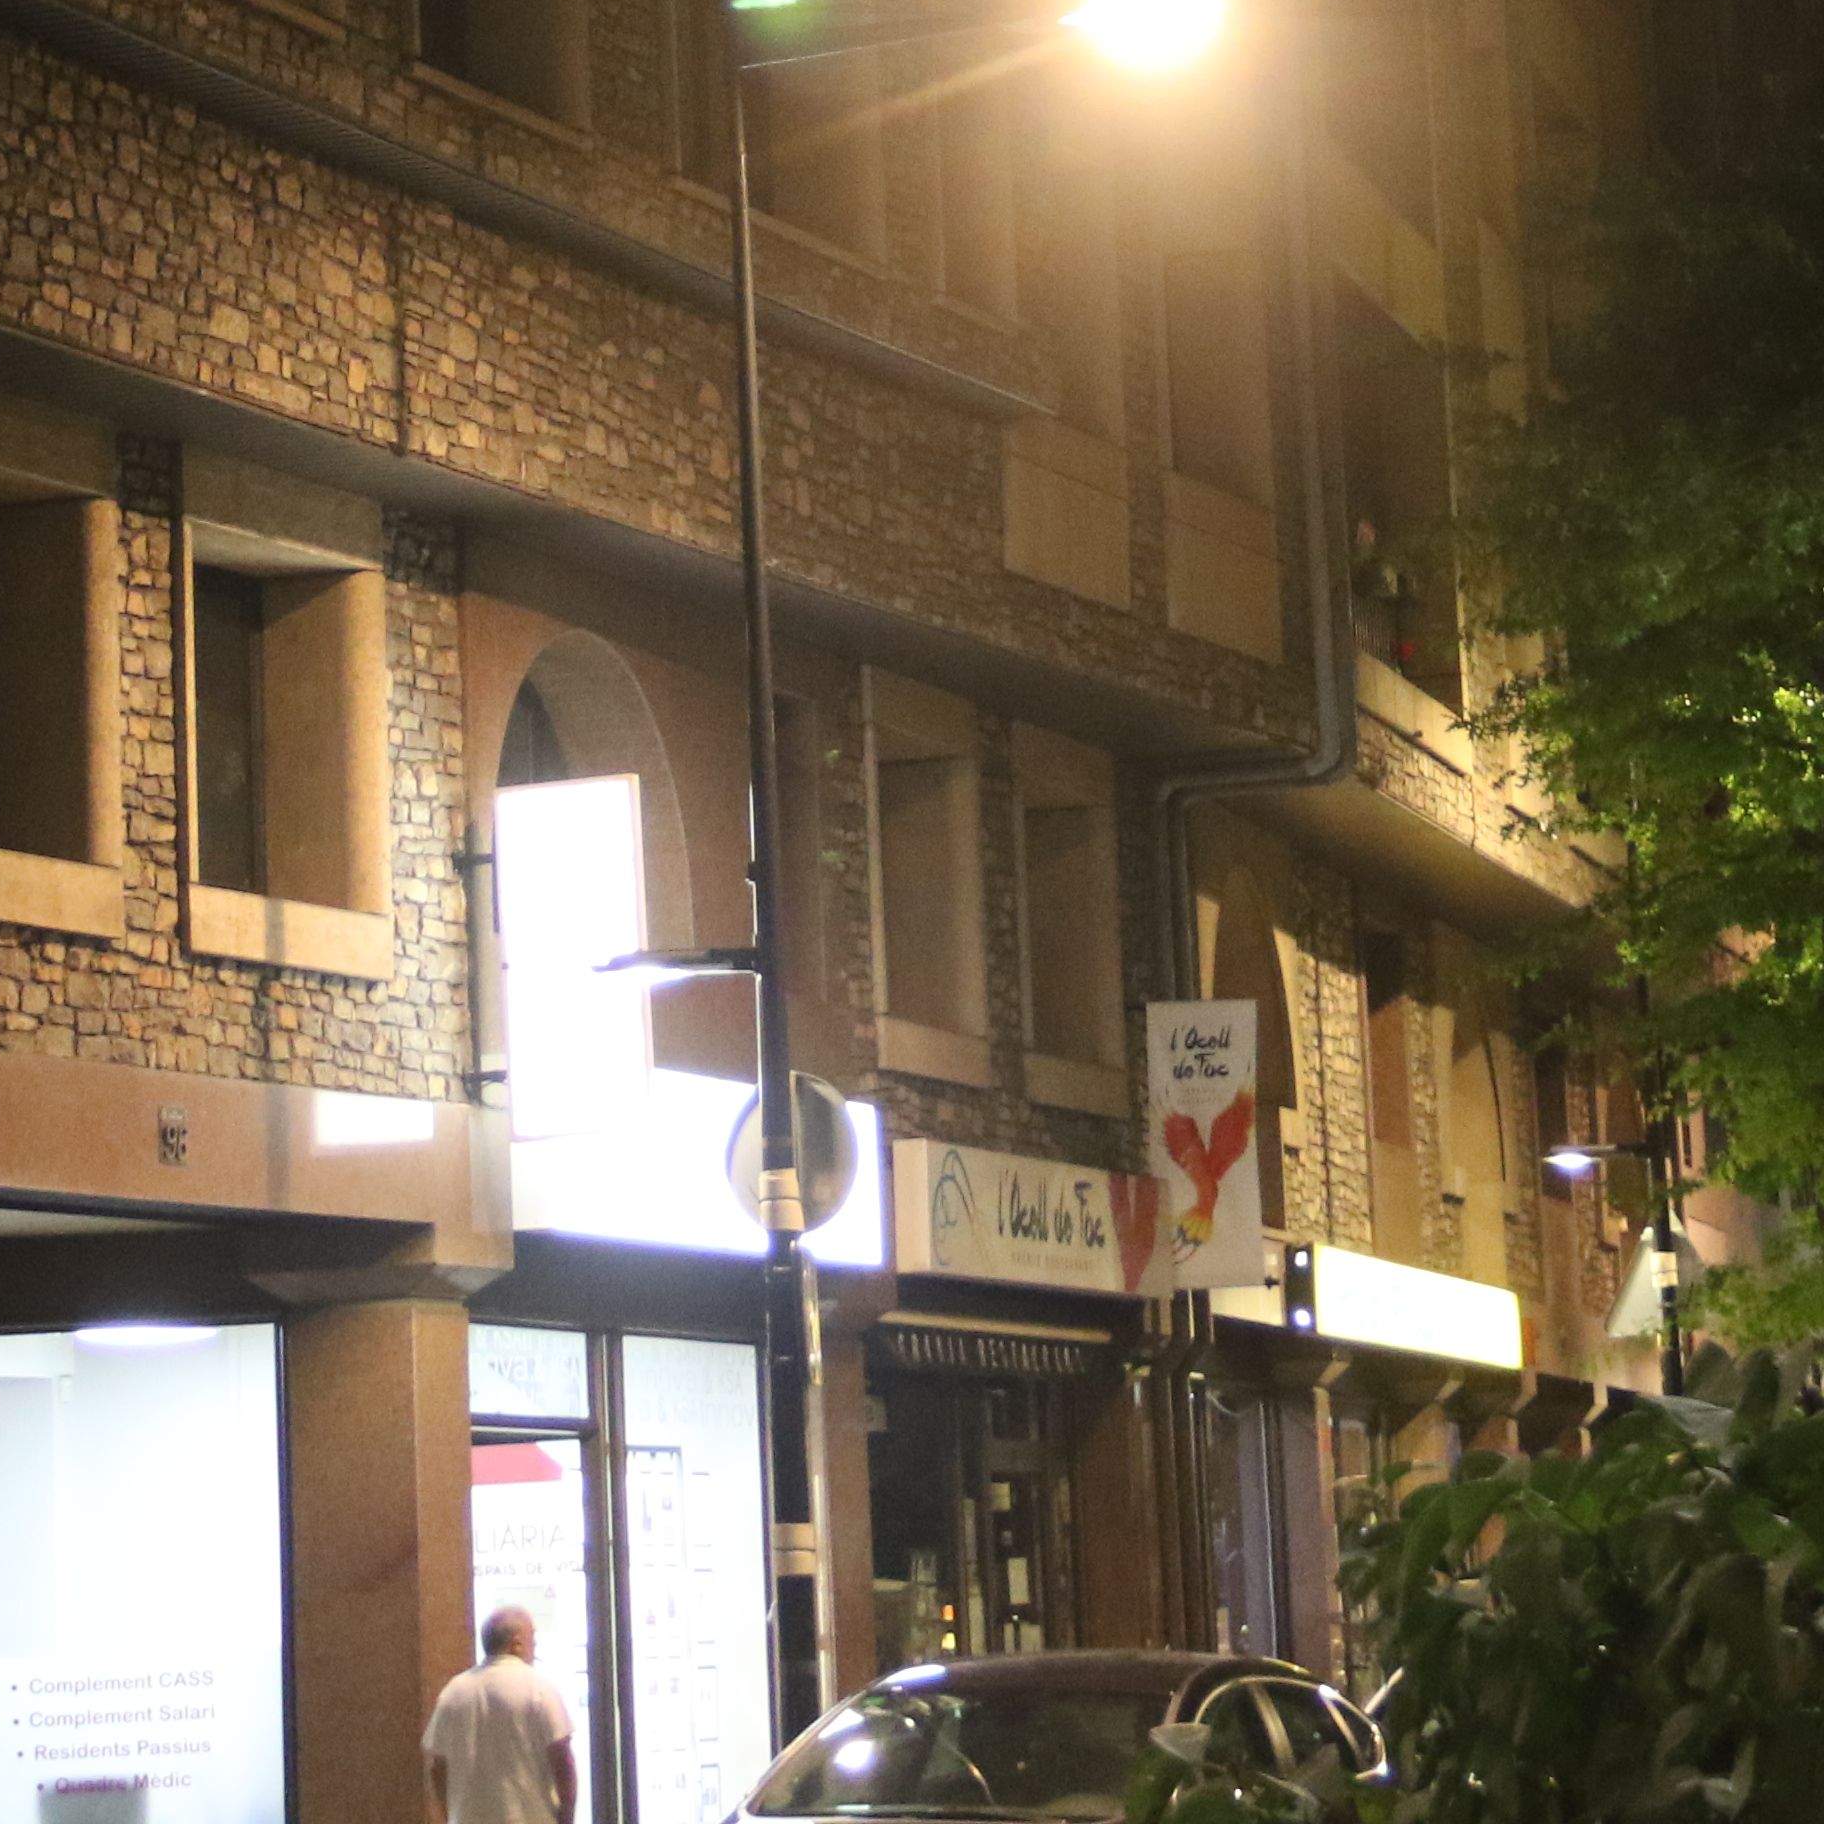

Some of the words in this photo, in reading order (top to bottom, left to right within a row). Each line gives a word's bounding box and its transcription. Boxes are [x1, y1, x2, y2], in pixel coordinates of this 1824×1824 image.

[29, 1674, 153, 1696] Complement
[158, 1670, 215, 1688] CASS
[29, 1707, 153, 1729] Complement
[159, 1704, 216, 1722] Salari
[33, 1742, 131, 1761] Residents
[136, 1738, 212, 1757] Passius
